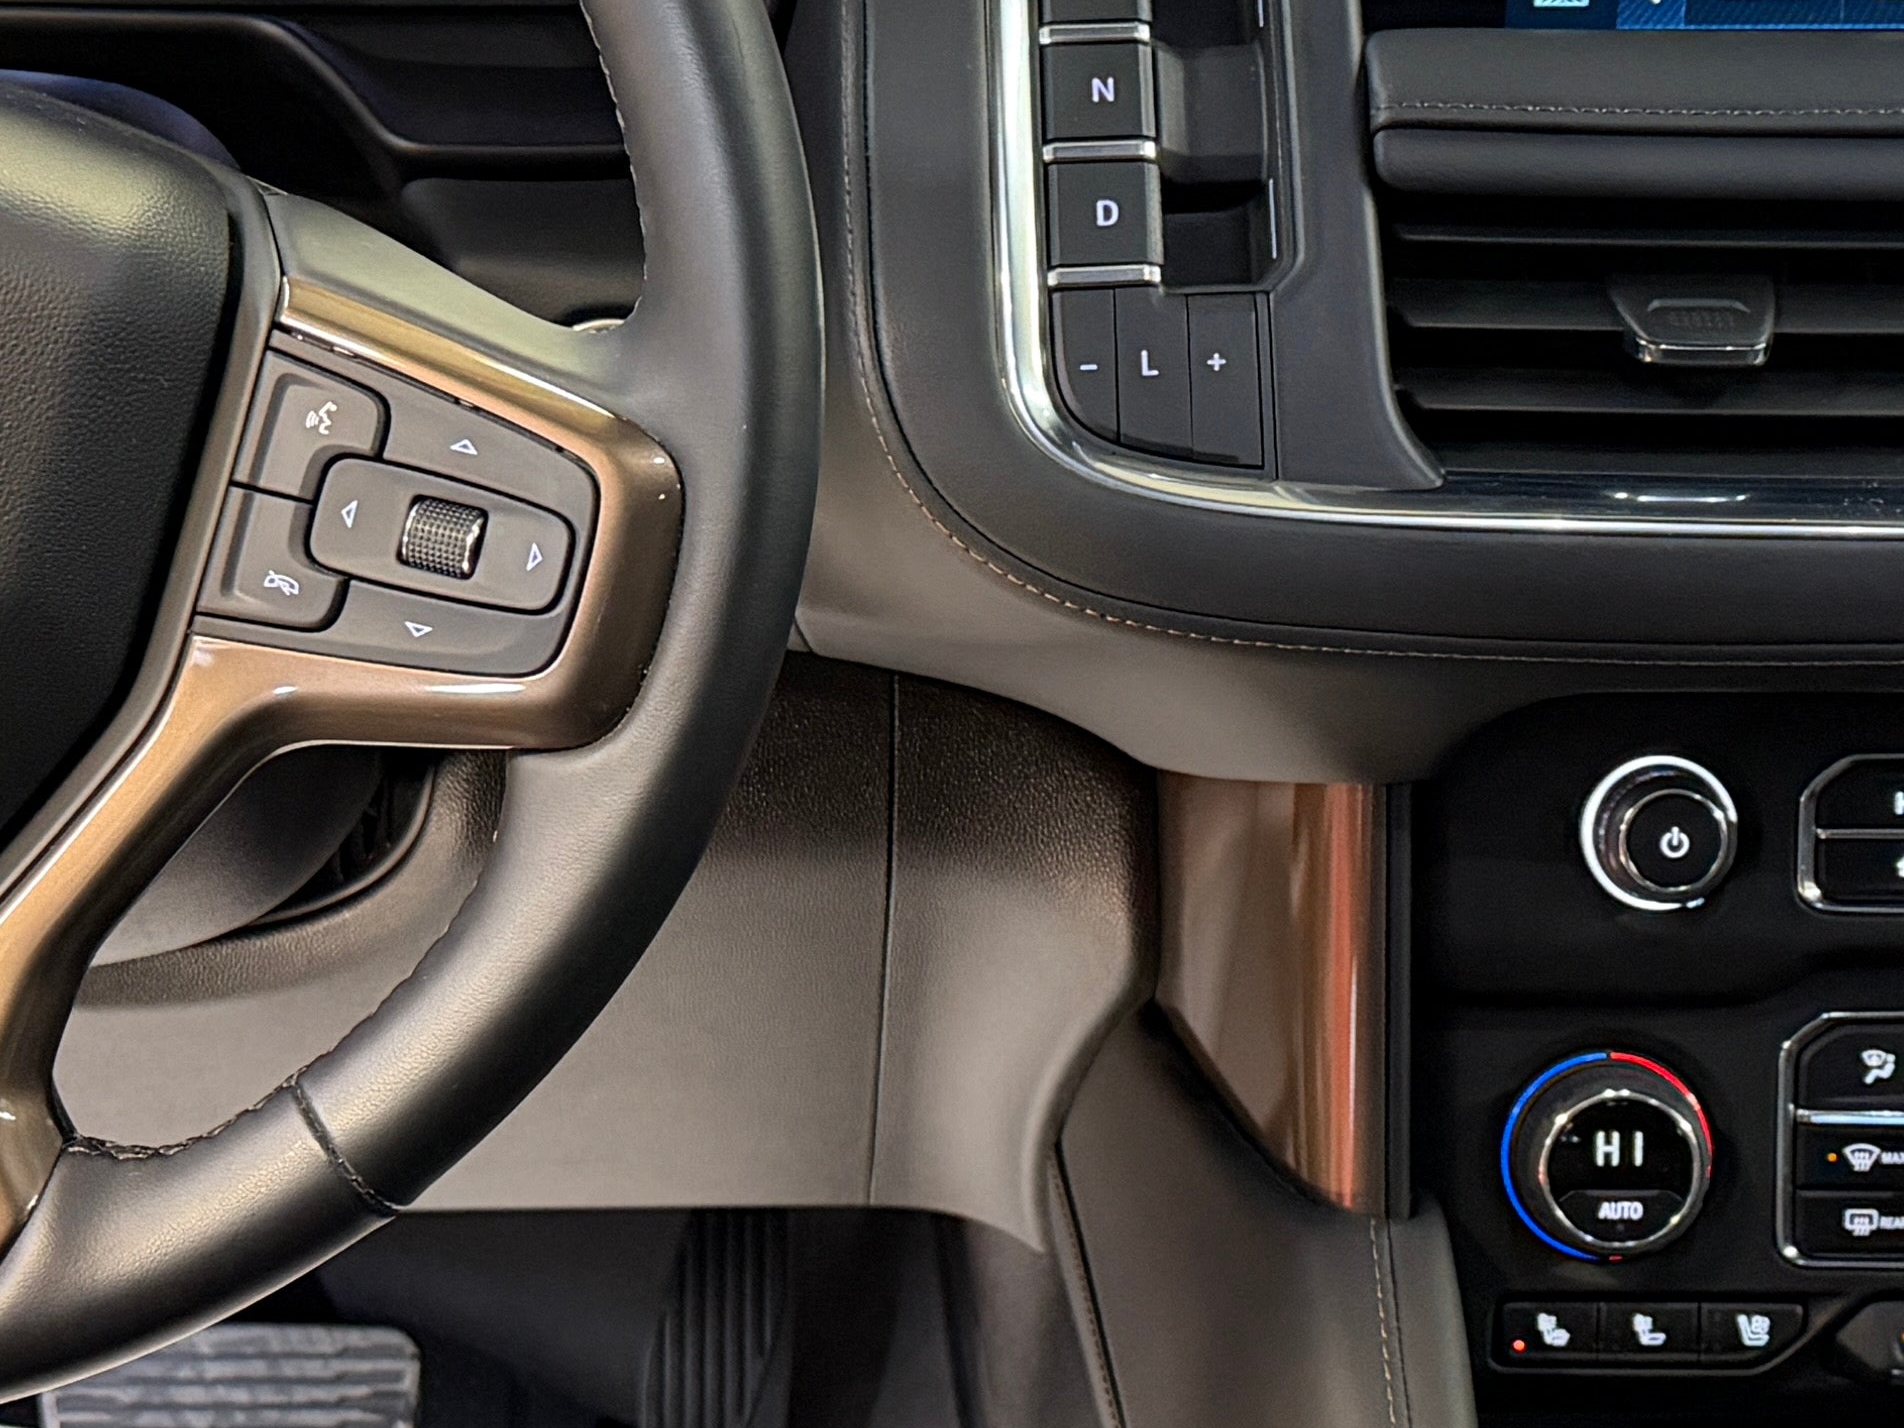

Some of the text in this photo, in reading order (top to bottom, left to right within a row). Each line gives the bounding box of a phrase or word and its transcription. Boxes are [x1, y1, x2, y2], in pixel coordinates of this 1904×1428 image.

[1091, 77, 1115, 103] N
[1095, 200, 1120, 227] D
[1140, 348, 1159, 377] L
[1598, 1201, 1644, 1222] AUTO
